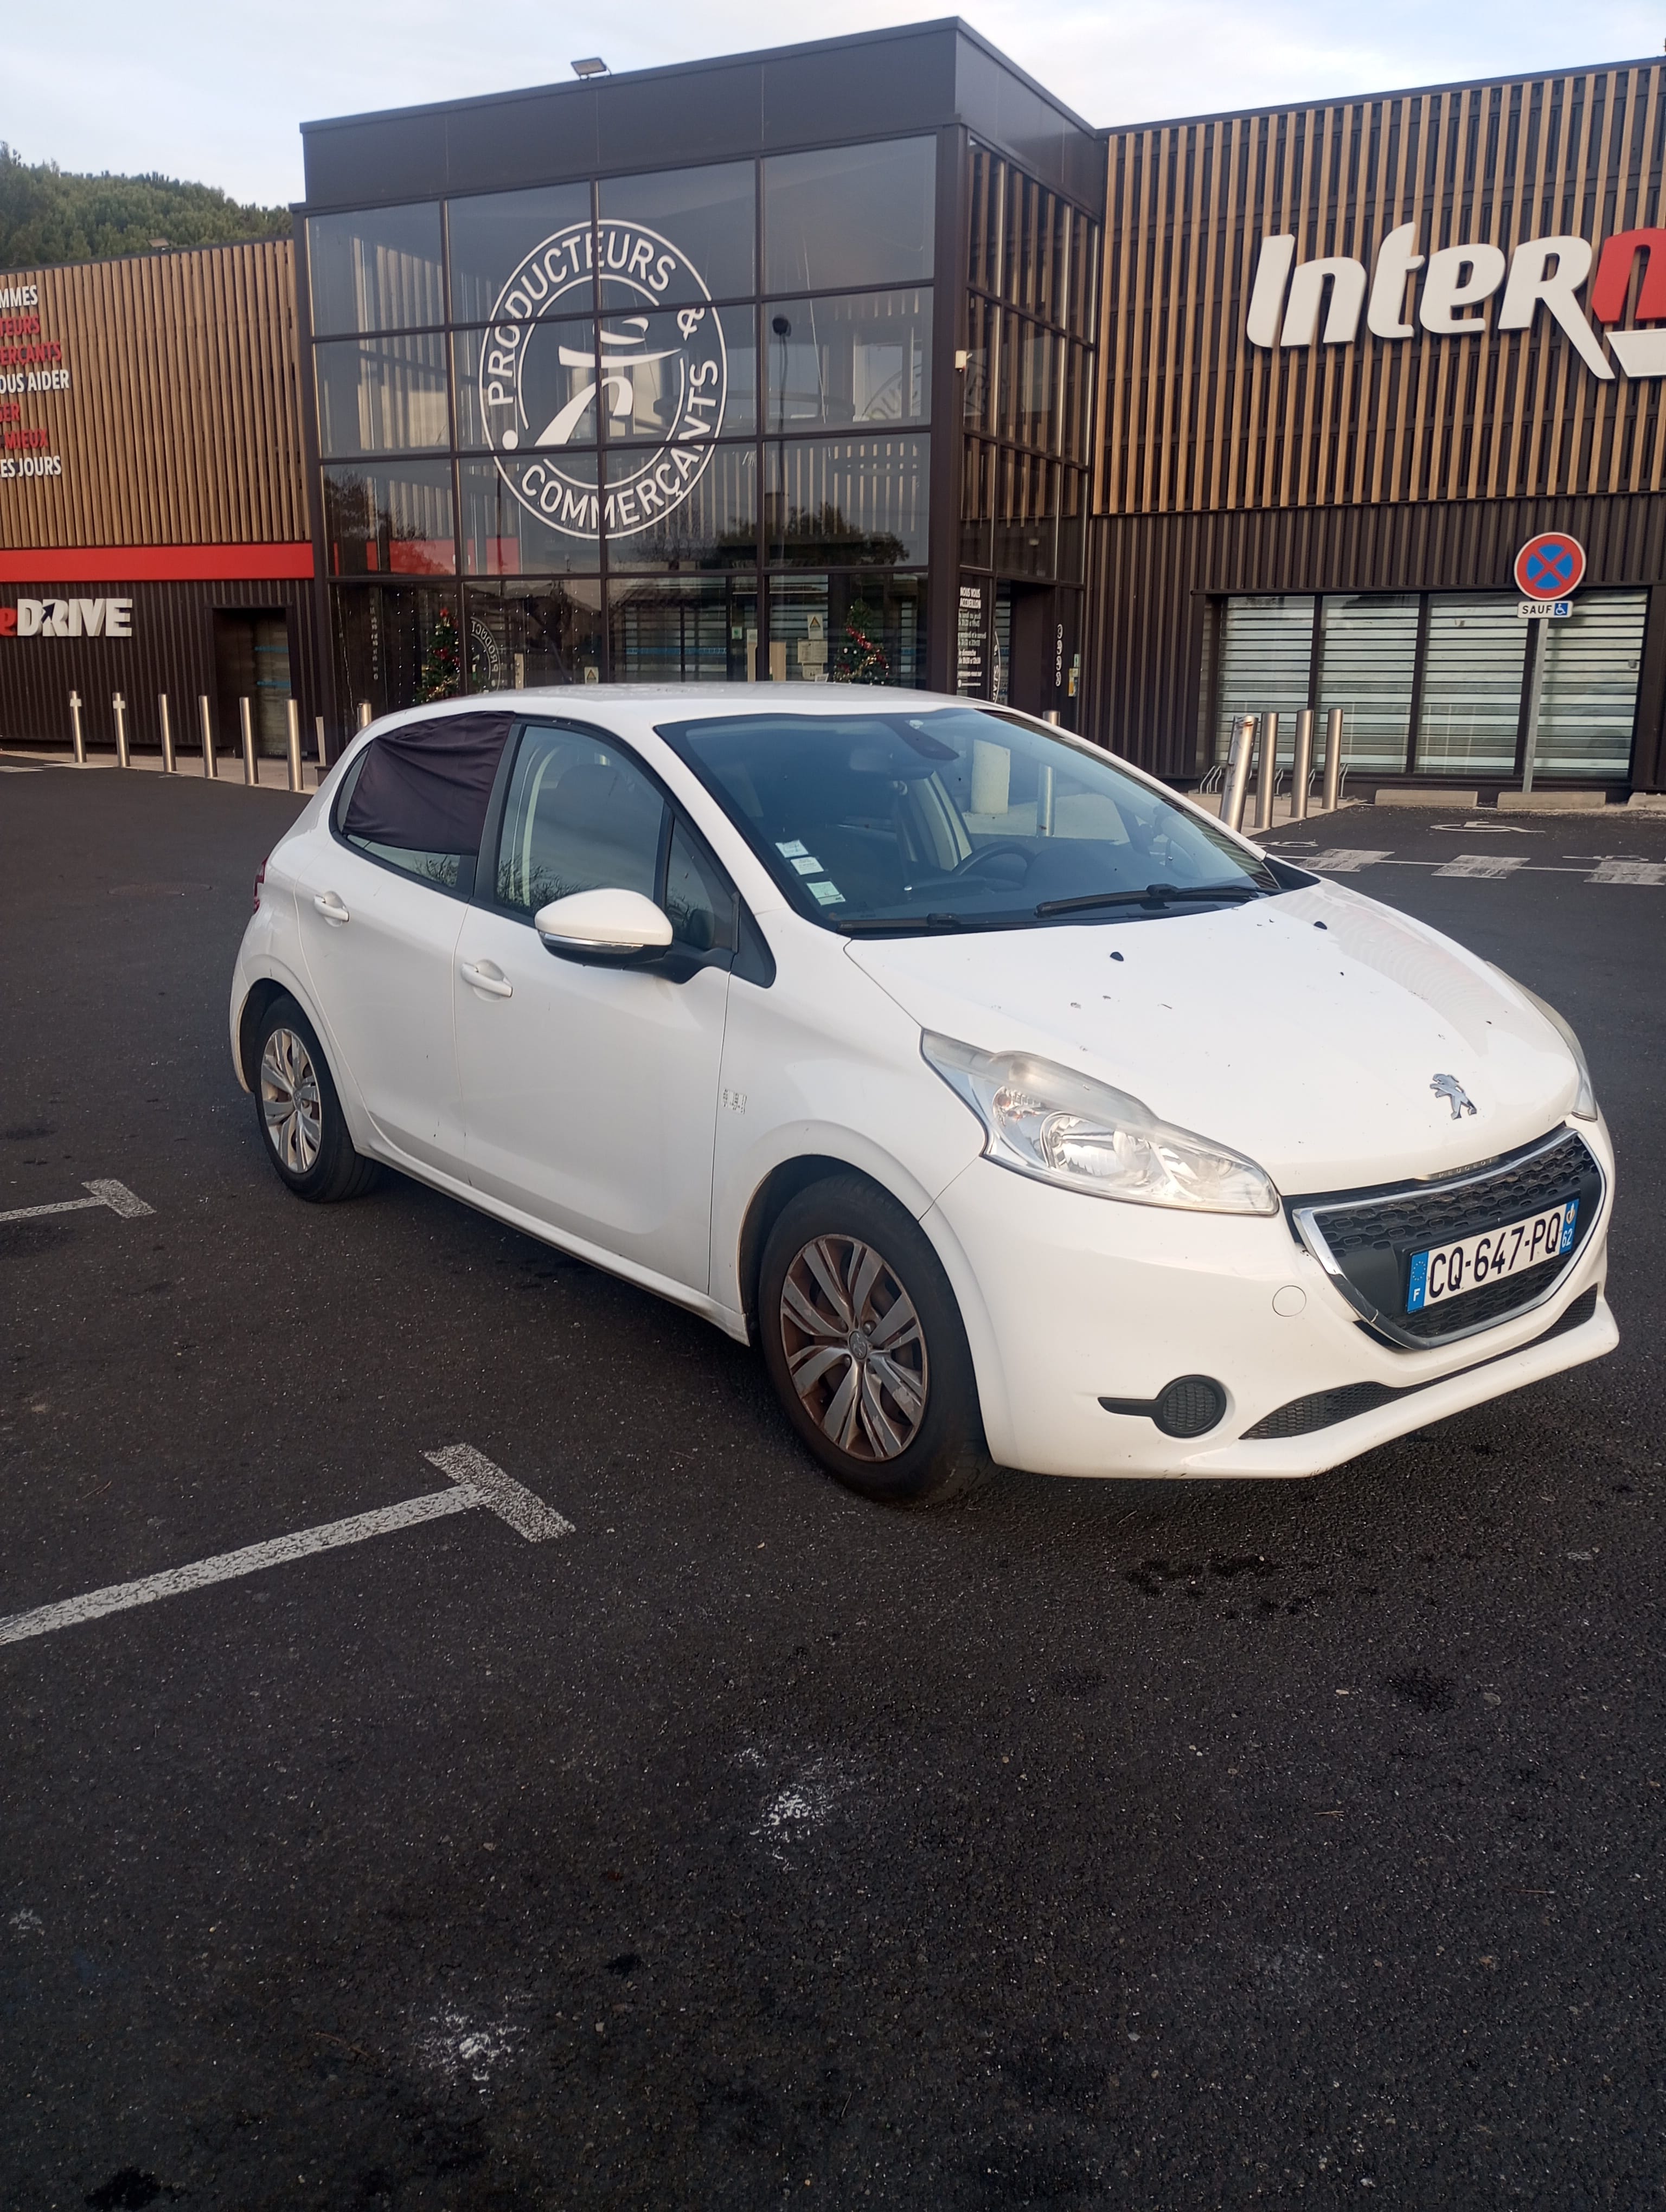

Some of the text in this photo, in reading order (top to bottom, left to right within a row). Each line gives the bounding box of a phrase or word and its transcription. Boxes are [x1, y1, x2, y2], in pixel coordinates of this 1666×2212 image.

[488, 231, 676, 406] PRODUCTEURS
[28, 369, 69, 391] AIDER
[4, 429, 48, 449] MIEUX
[522, 360, 719, 529] COMMERÇANTS
[0, 455, 62, 478] ES JOURS
[1522, 605, 1552, 614] SAUF
[1413, 1212, 1573, 1302] F CQ-647-PQ 62
